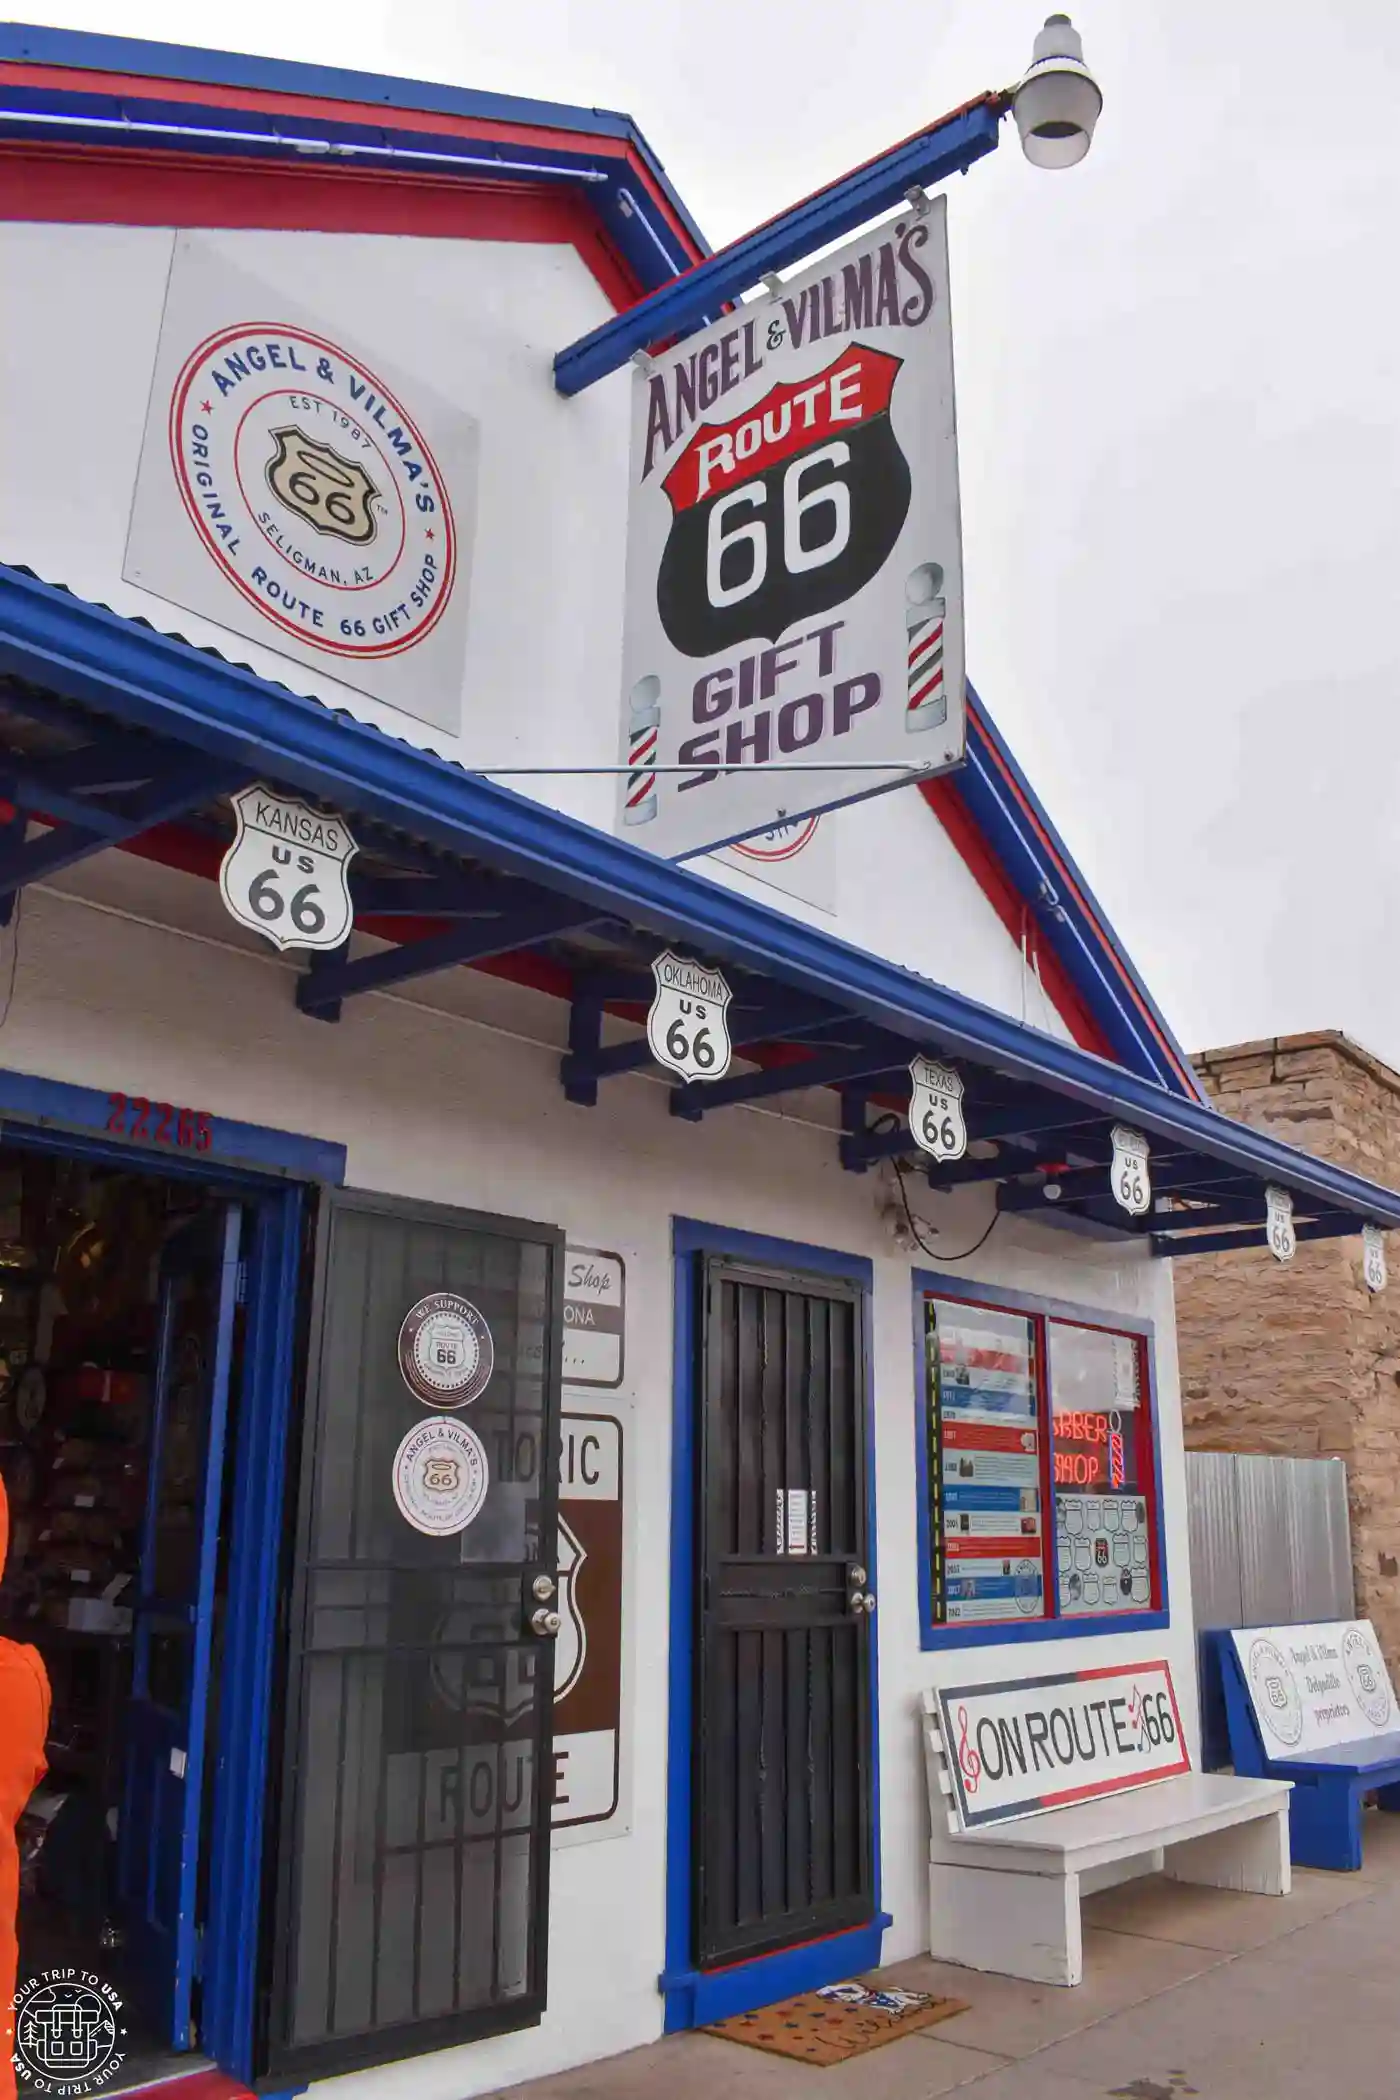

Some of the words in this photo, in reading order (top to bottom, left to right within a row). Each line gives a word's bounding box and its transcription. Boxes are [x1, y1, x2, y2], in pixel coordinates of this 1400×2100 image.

[640, 316, 762, 484] ANGEL
[766, 318, 787, 351] &
[778, 222, 934, 349] VILMA'S
[211, 343, 307, 397] ANGEL
[316, 357, 334, 385] &
[349, 374, 436, 514] VILMA'S
[289, 395, 323, 414] EST
[332, 411, 372, 449] 1987
[696, 362, 863, 502] ROUTE
[288, 471, 355, 525] 66
[191, 423, 242, 556] ORIGINAL
[251, 565, 325, 629] ROUTE
[340, 618, 366, 637] 66
[373, 602, 411, 635] GIFT
[411, 555, 438, 608] SHOP
[706, 441, 851, 608] 66
[355, 565, 375, 583] AZ
[692, 620, 845, 725] GIFT
[678, 672, 882, 793] SHOP
[255, 801, 339, 851] KANSAS
[272, 844, 315, 874] US
[248, 868, 326, 935] 66
[664, 964, 723, 1001] OKLAHOMA
[679, 998, 707, 1020] US
[666, 1018, 715, 1068] 66
[929, 1093, 949, 1111] US
[922, 1110, 956, 1150] 66
[1121, 1171, 1143, 1204] 66
[1272, 1225, 1290, 1253] 66
[567, 1264, 612, 1295] Shop
[1368, 1260, 1383, 1284] 66
[434, 1299, 480, 1324] SUPPORT
[437, 1349, 457, 1365] 66
[406, 1430, 435, 1462] ANGEL
[438, 1427, 445, 1437] &
[430, 1473, 452, 1486] 66
[1025, 1697, 1136, 1772] ROUTE
[1142, 1691, 1175, 1746] 66
